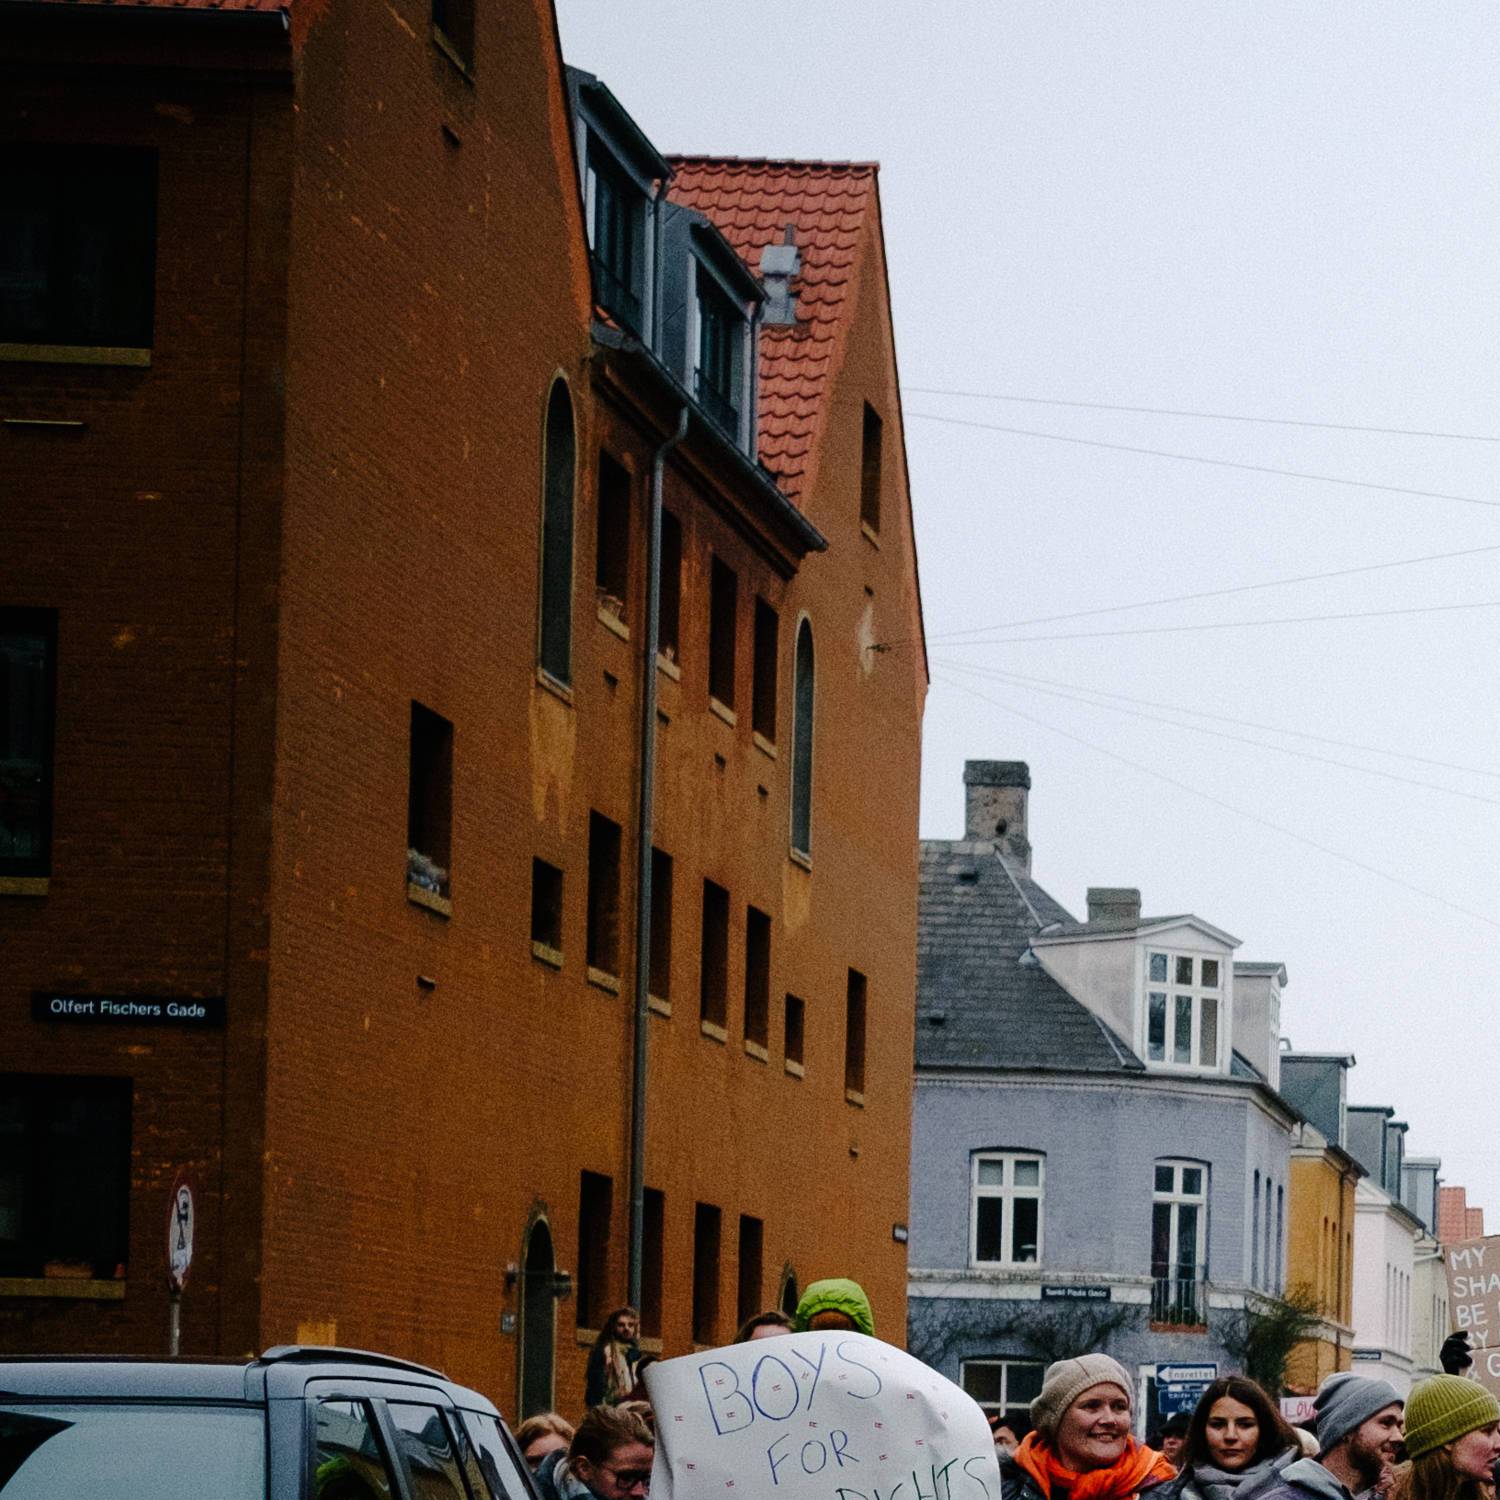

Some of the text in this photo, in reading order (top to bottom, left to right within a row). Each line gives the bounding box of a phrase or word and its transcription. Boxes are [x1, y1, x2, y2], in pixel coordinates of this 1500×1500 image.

[50, 999, 206, 1018] Olfert Fischers Gade
[1450, 1246, 1486, 1270] MY
[1456, 1303, 1488, 1328] BE
[1168, 1370, 1213, 1379] Ensrettet
[698, 1340, 882, 1436] BOYS
[767, 1429, 860, 1486] FOR
